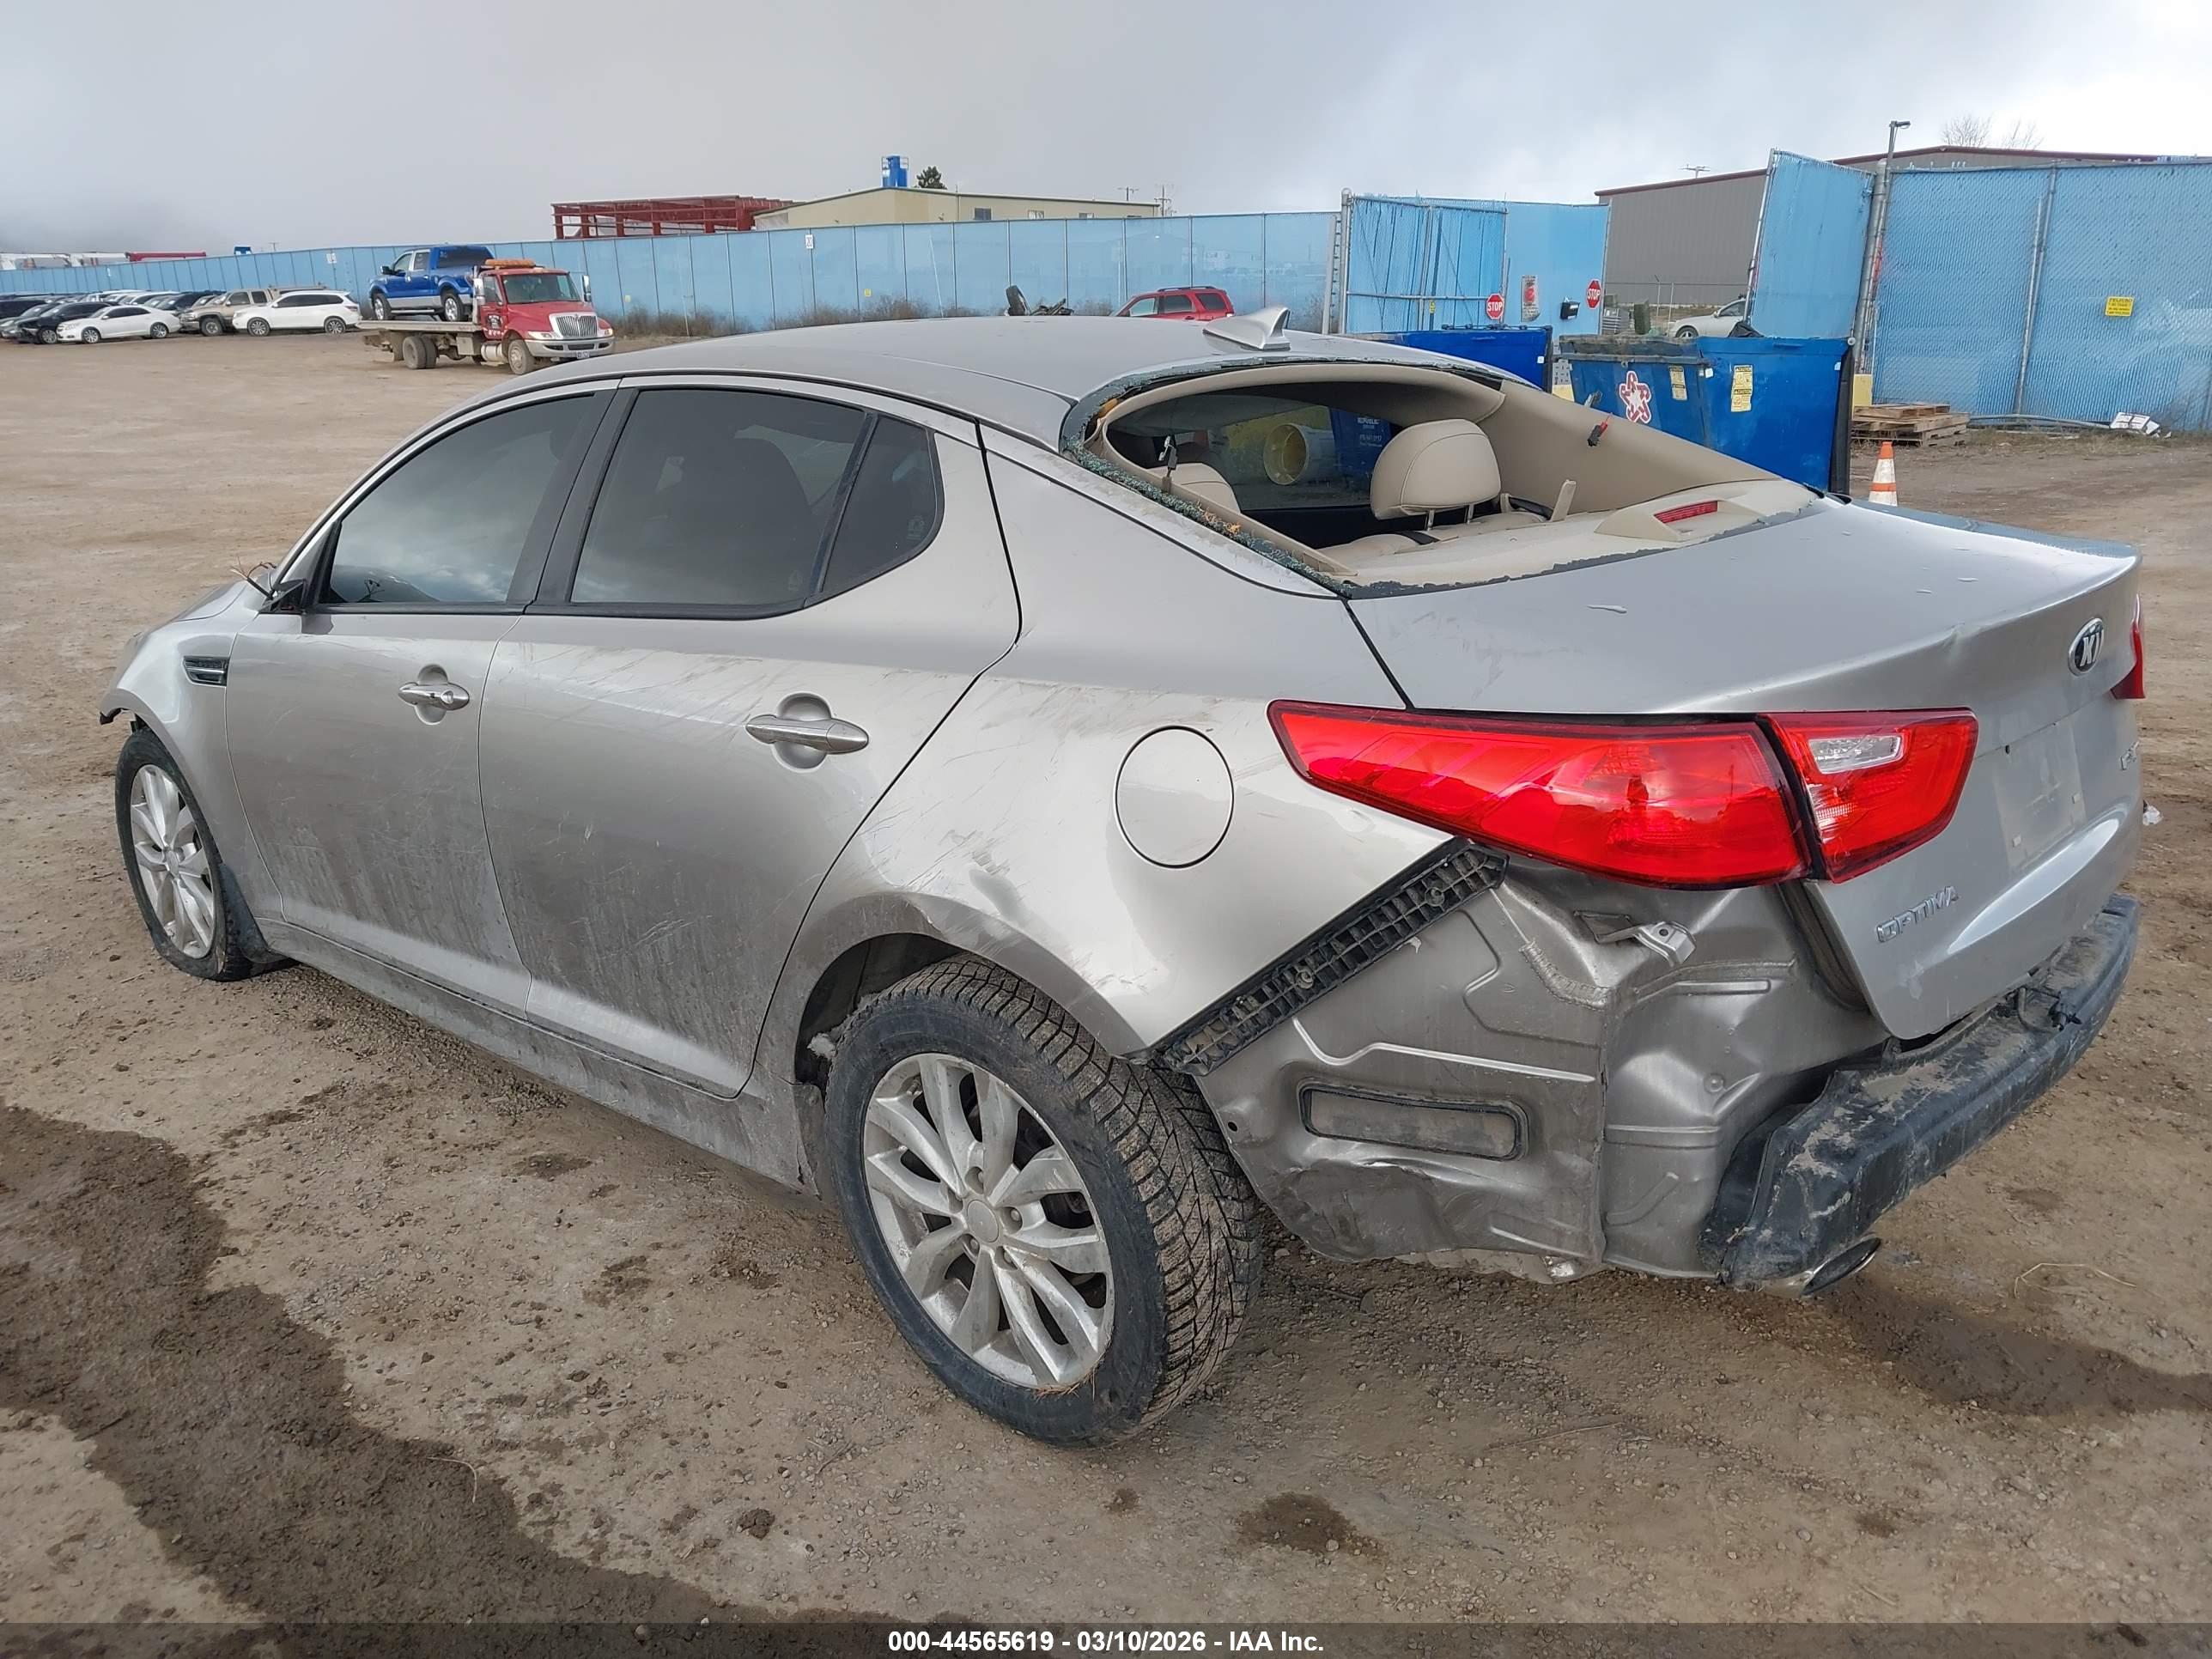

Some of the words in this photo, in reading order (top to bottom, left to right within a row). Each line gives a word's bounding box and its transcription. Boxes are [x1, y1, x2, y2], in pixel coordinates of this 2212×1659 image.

[1587, 289, 1601, 300] STOP
[1487, 301, 1503, 311] STOP
[1877, 886, 1959, 943] OPTIMA
